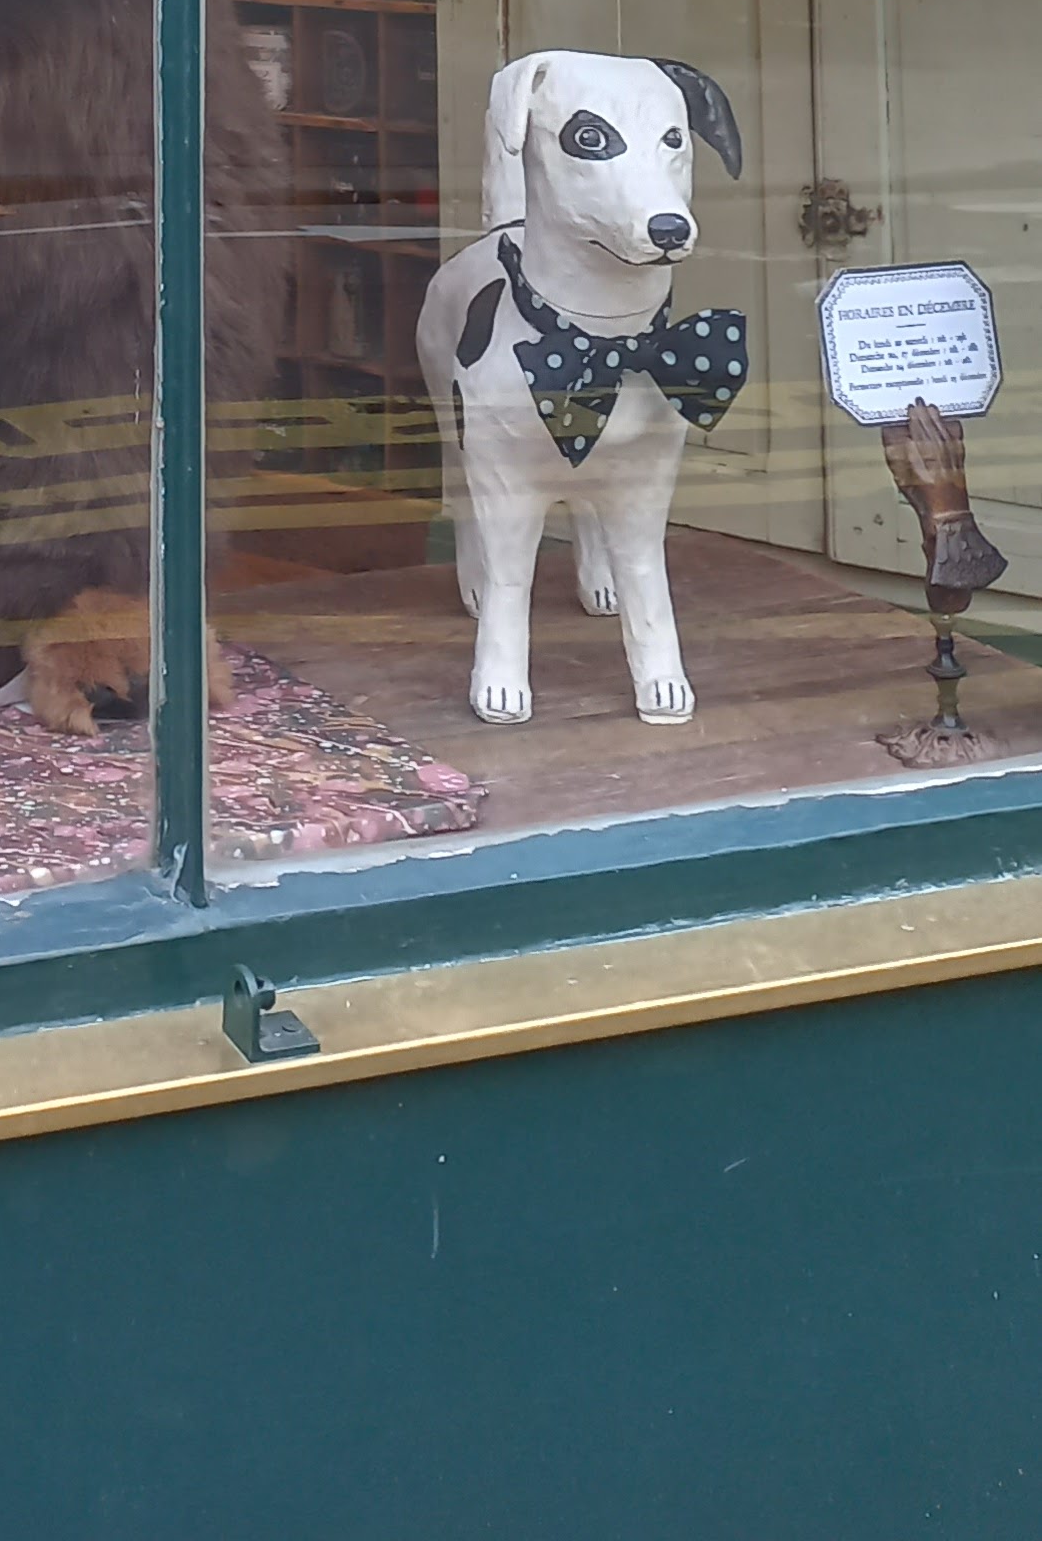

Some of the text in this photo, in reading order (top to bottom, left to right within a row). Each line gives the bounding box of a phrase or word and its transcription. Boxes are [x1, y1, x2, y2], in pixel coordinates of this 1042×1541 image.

[838, 299, 976, 321] HORAIRES EN DÉCEMBRE
